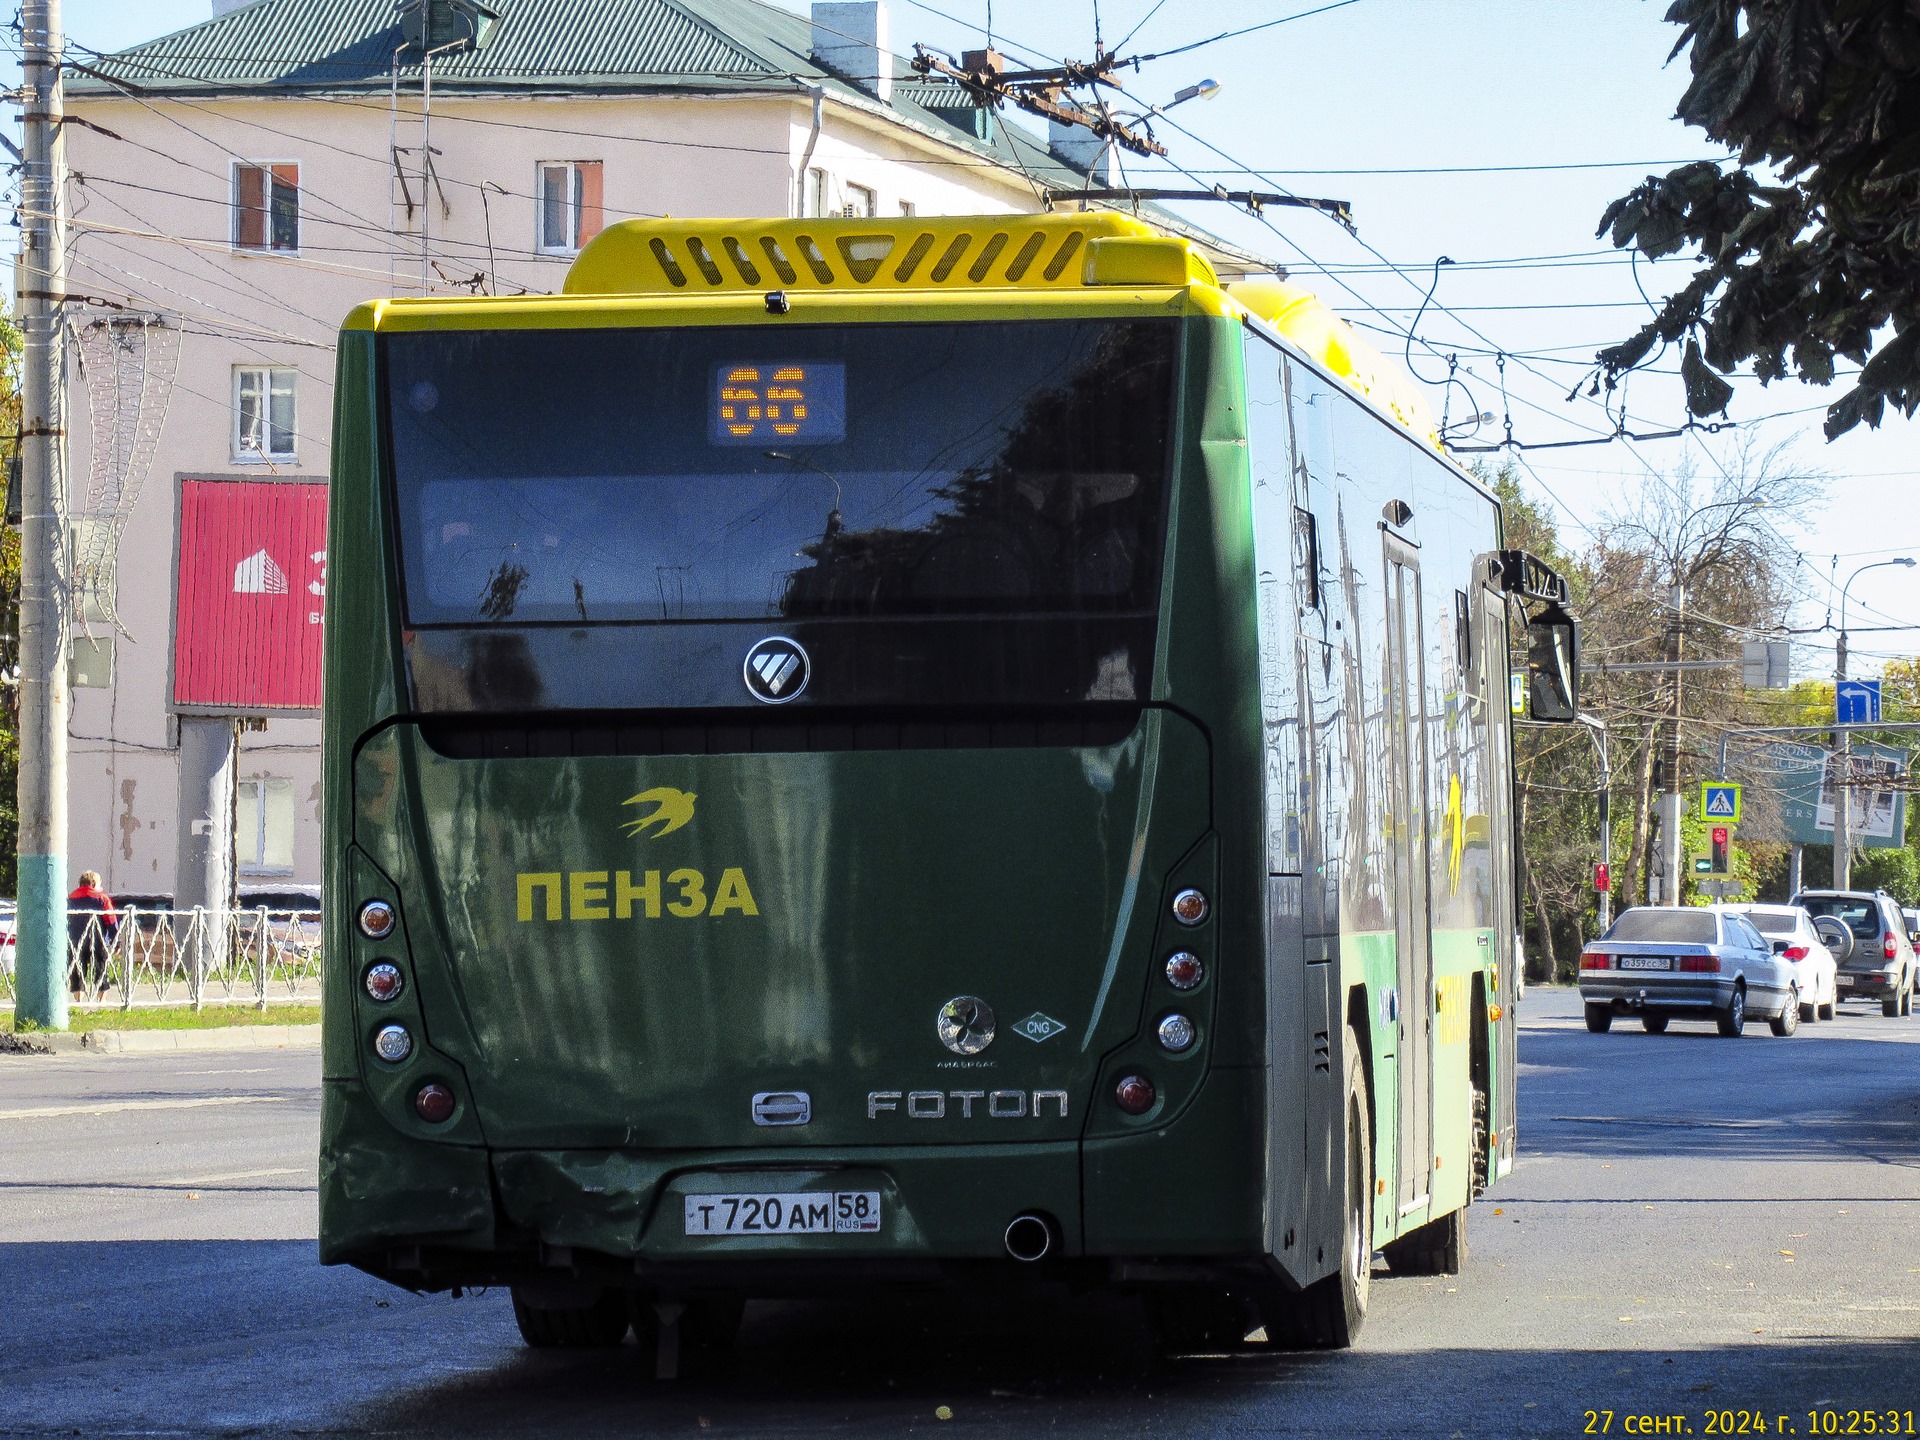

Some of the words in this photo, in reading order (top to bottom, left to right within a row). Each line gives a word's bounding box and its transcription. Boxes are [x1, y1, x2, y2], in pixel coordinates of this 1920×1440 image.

[721, 368, 807, 436] 66
[516, 867, 760, 922] ПЕНЗА
[1026, 1021, 1050, 1034] CNG
[867, 1090, 1068, 1119] FOTON
[837, 1194, 869, 1219] 58
[836, 1220, 860, 1230] RUS
